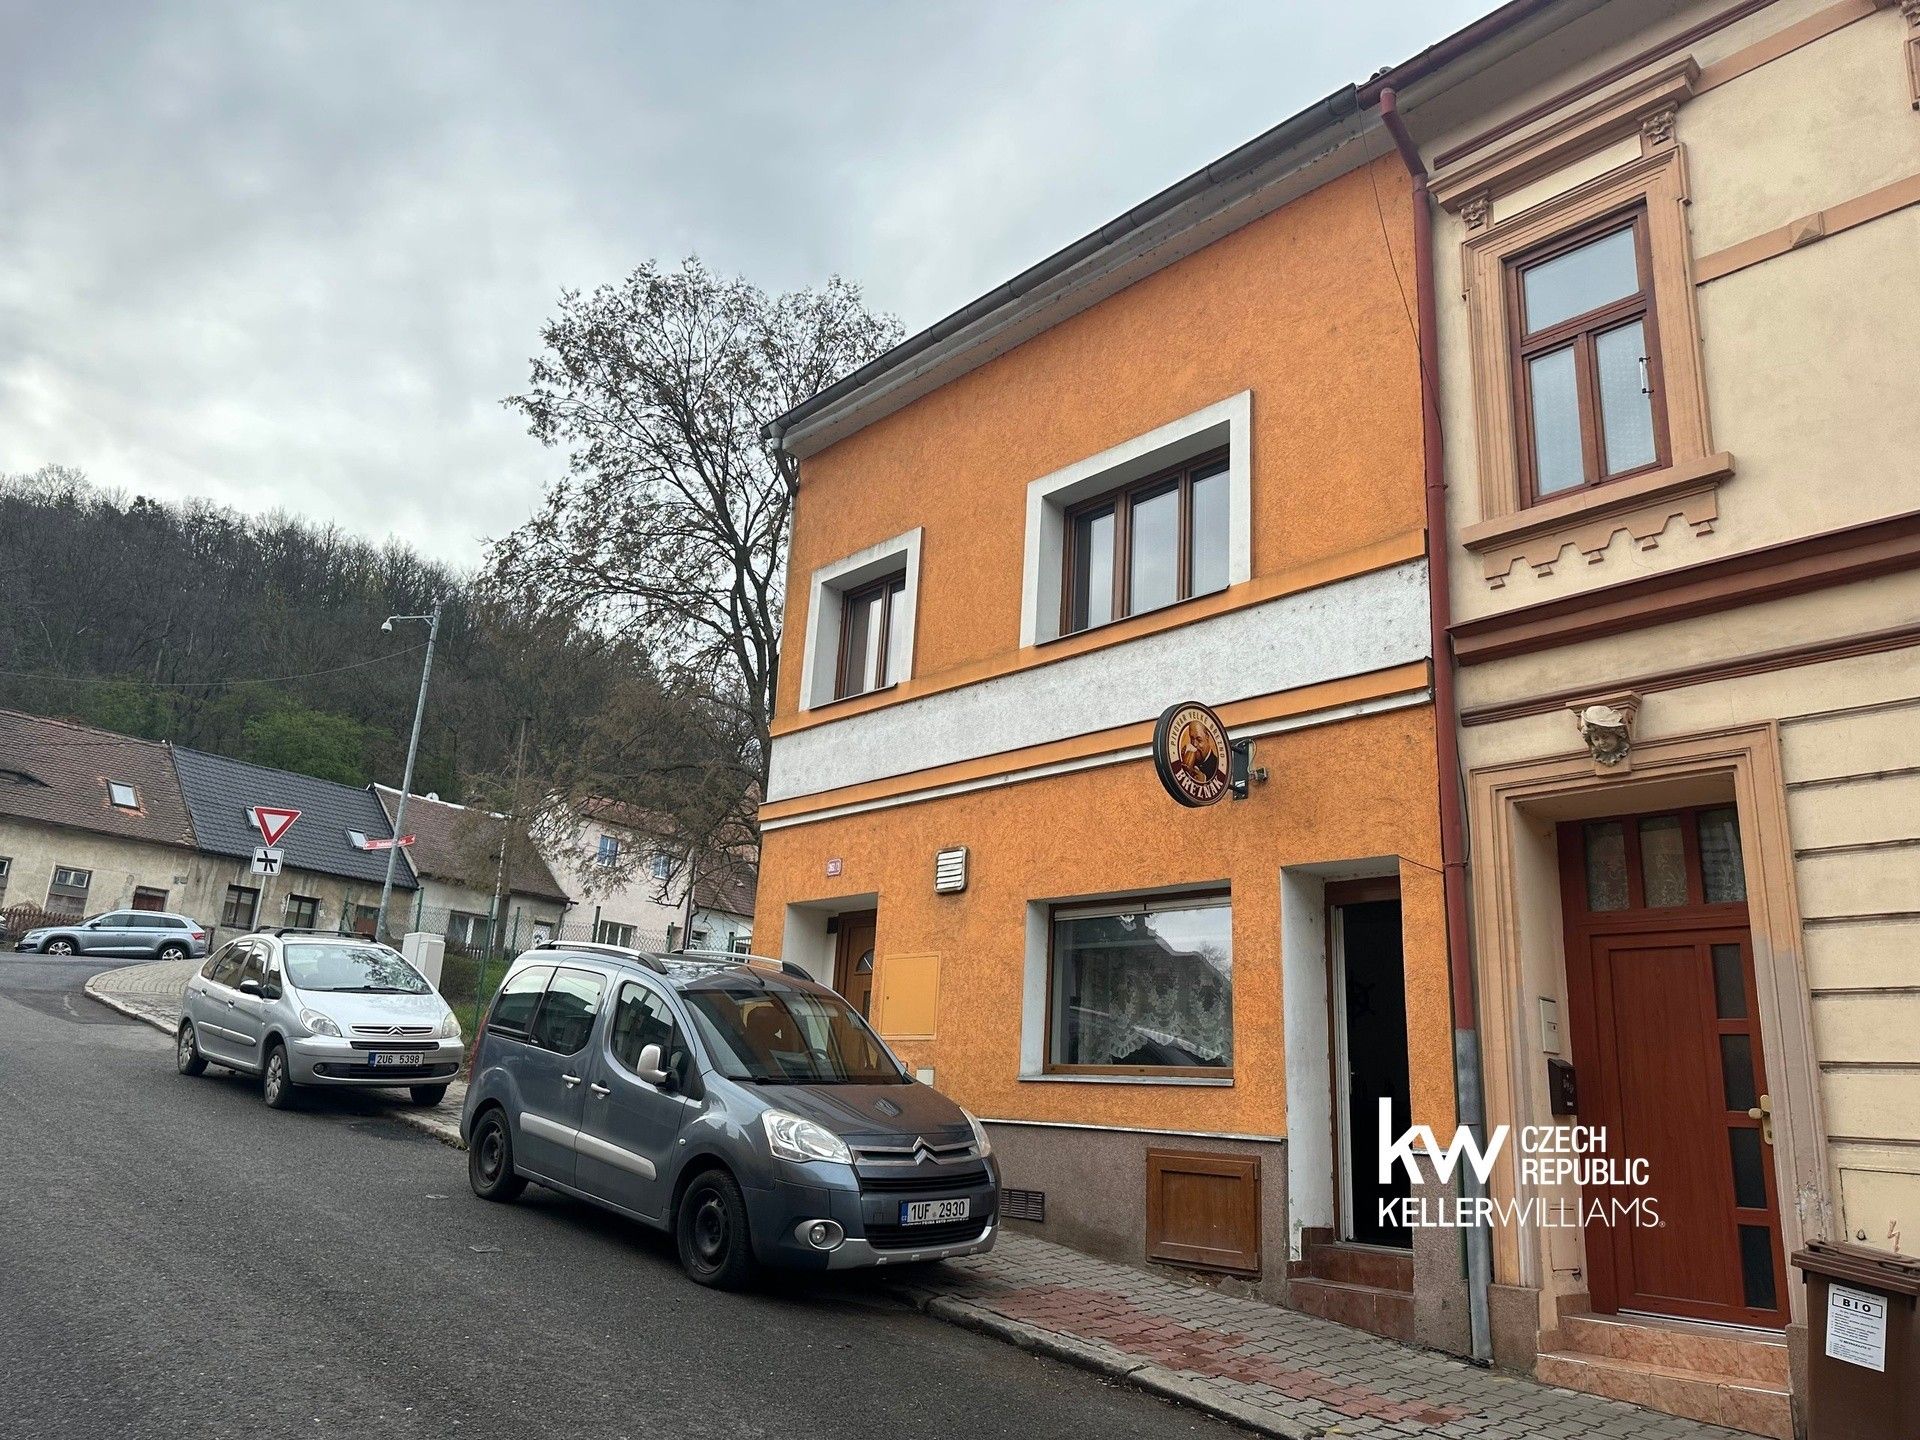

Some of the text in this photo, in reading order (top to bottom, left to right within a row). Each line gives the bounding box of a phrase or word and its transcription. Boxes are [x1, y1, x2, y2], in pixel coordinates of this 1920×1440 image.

[1170, 714, 1188, 747] PIVOVAR
[912, 1201, 965, 1220] 1UF 2930
[1842, 1298, 1870, 1312] BIO
